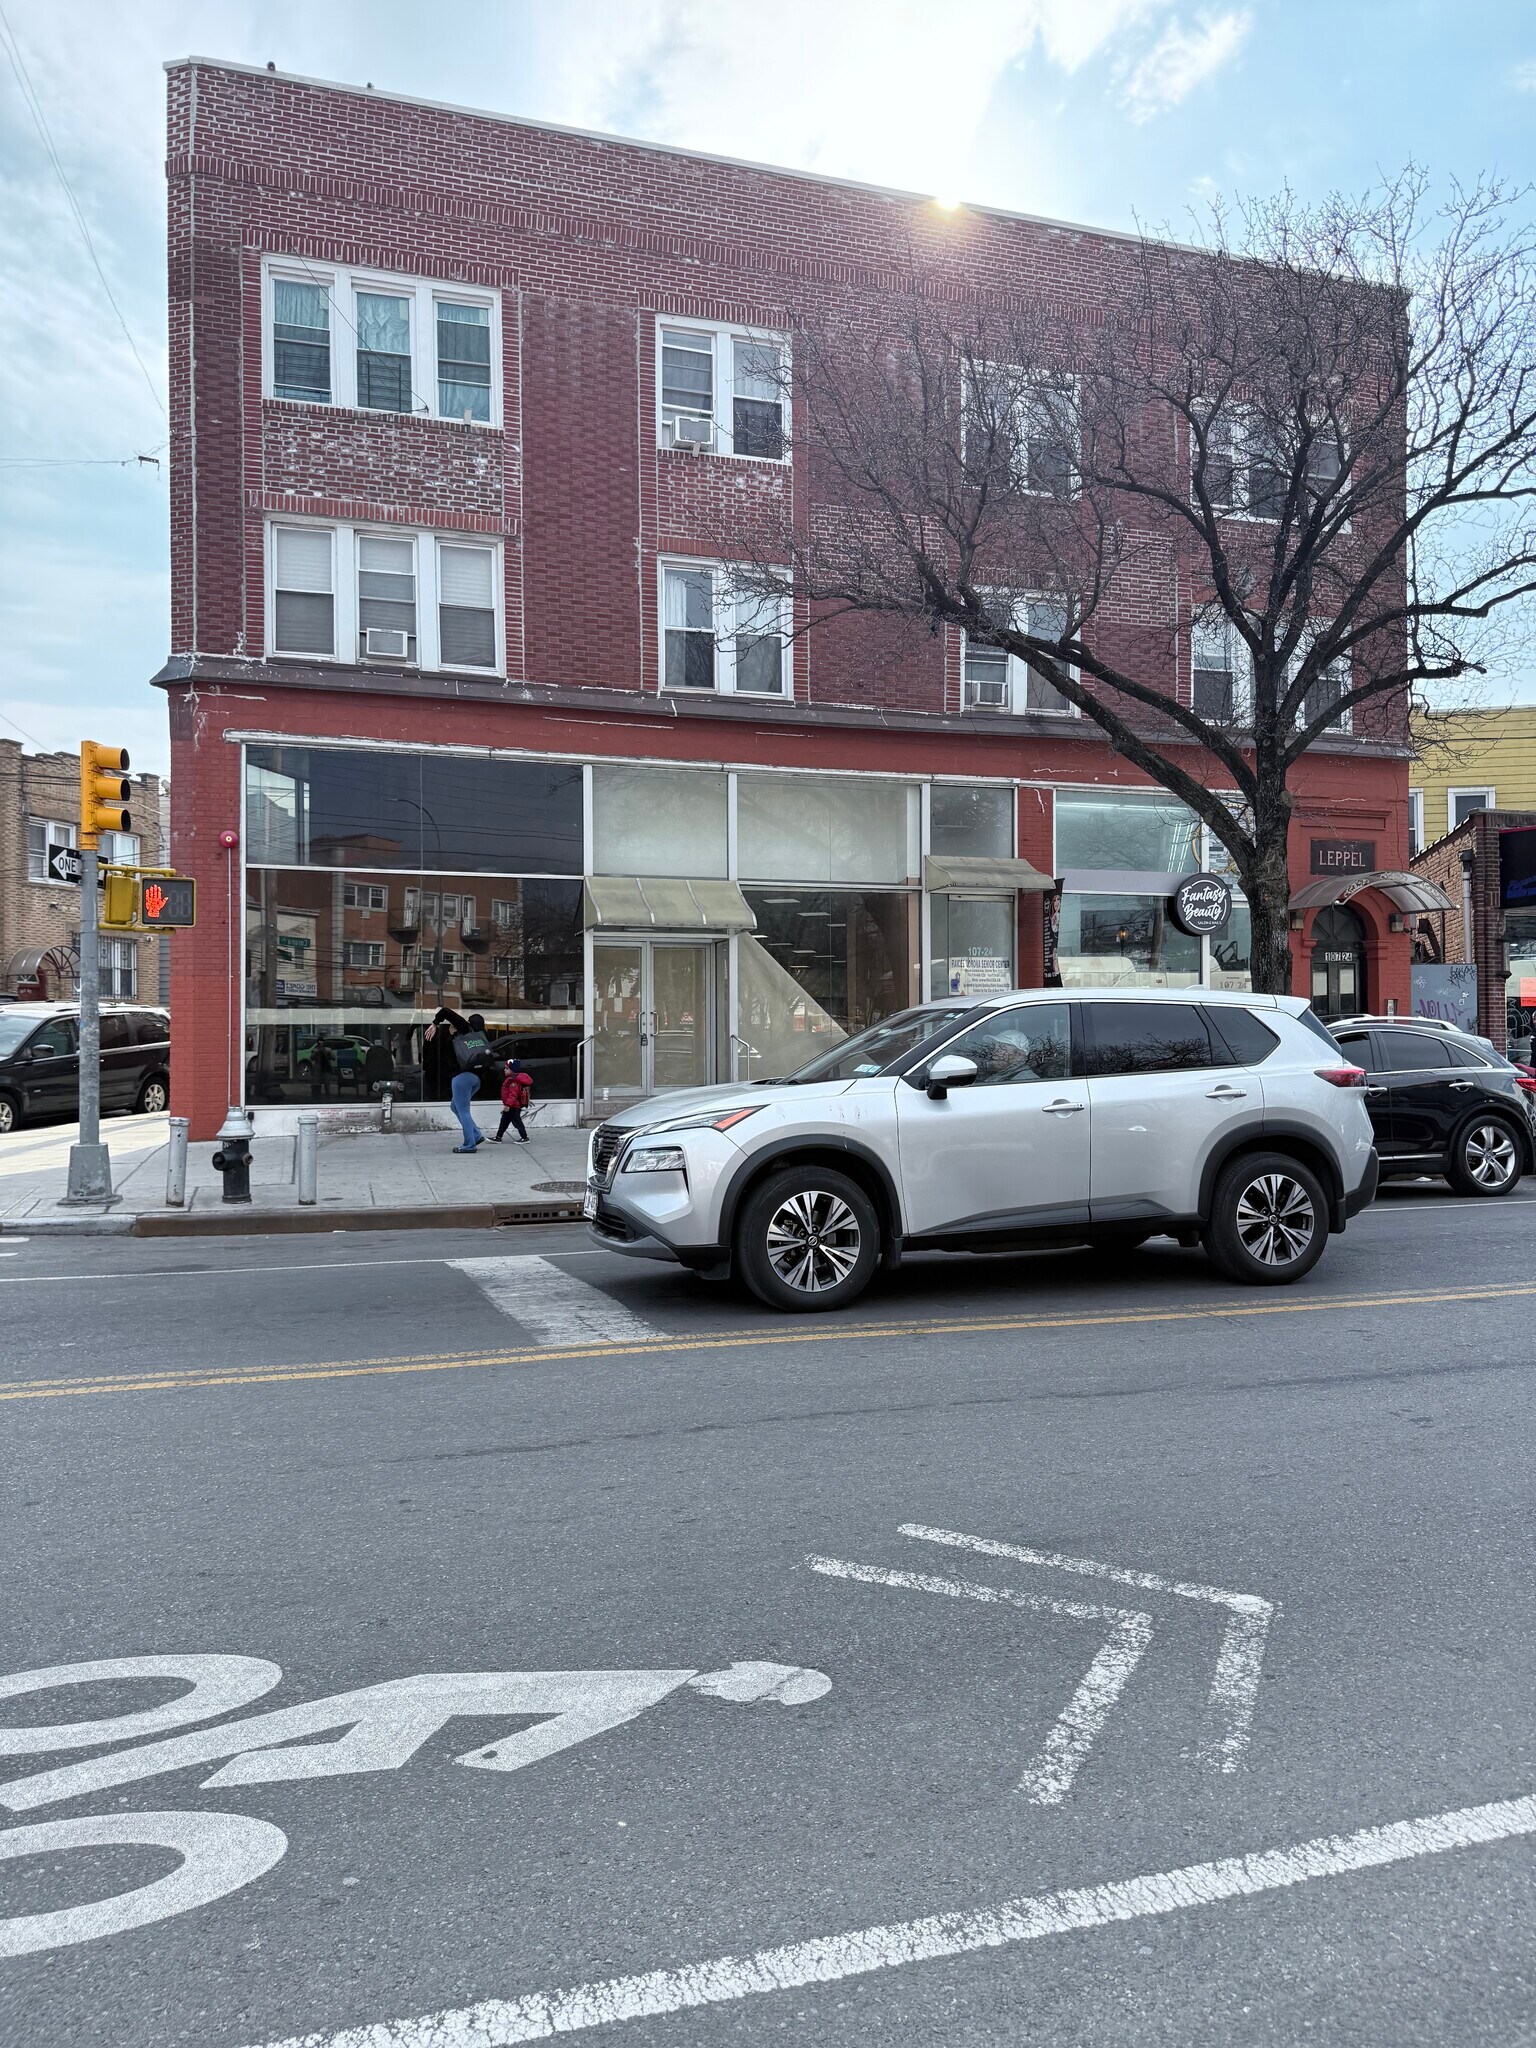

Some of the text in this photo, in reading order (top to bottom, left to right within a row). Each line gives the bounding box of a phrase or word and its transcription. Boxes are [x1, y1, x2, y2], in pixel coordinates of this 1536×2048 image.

[58, 856, 77, 873] ONE
[1319, 850, 1366, 867] LEPPEL
[1181, 885, 1227, 904] Fantasy
[1183, 902, 1223, 921] Beauty
[981, 960, 995, 969] SENIOR
